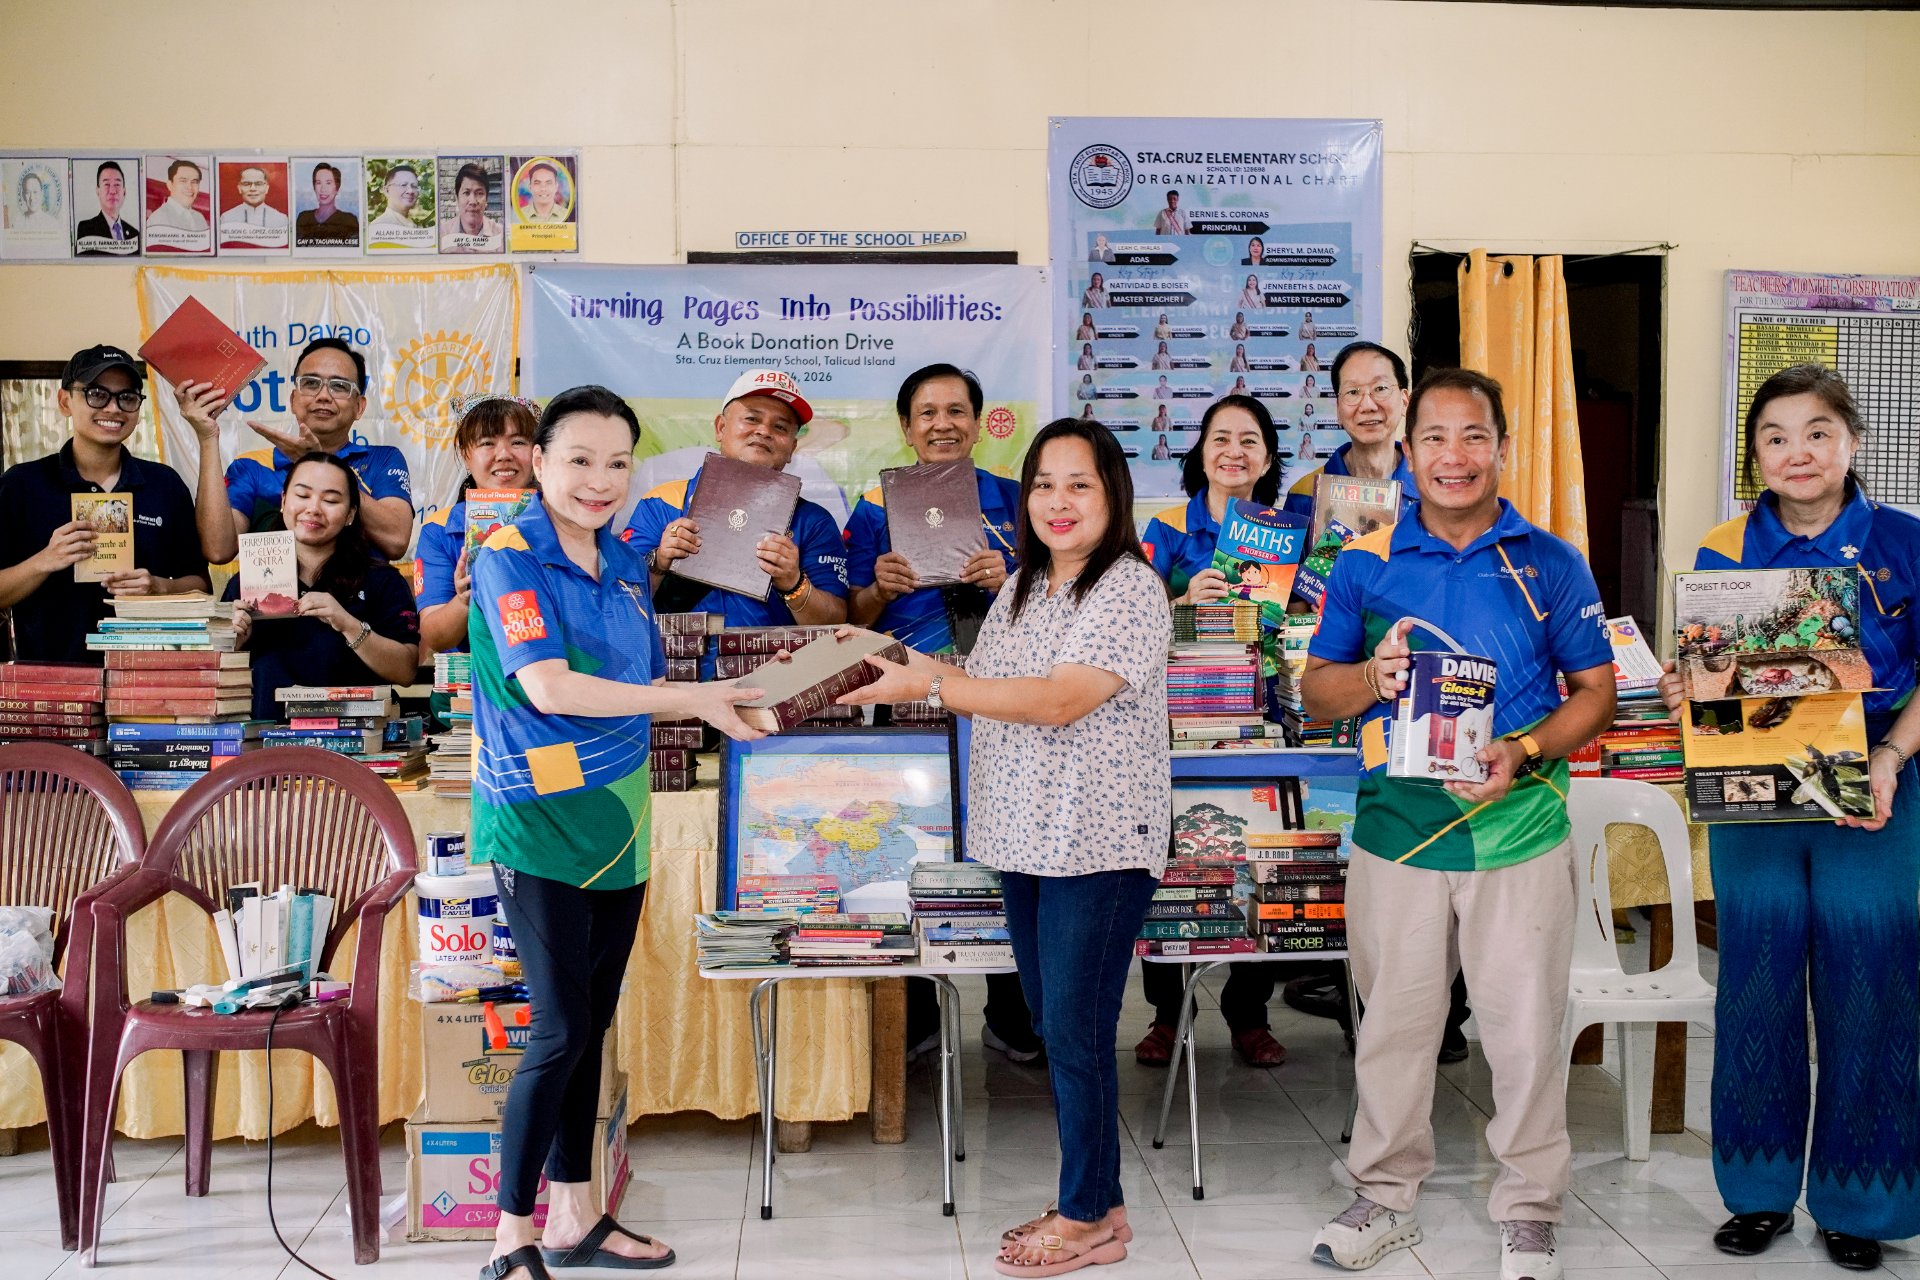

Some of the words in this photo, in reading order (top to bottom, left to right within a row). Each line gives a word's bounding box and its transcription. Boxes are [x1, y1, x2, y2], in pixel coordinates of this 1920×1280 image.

[1206, 153, 1296, 164] ELEMENTARY
[1137, 174, 1292, 186] ORGANIZATIONAL
[1190, 211, 1218, 219] BERNIE
[1220, 211, 1228, 219] S.
[1230, 212, 1269, 220] CORONAS
[1202, 224, 1242, 232] PRINCIPAL
[739, 232, 789, 246] OFFICE
[796, 232, 816, 246] OF
[820, 233, 848, 246] THE
[855, 233, 915, 246] SCHOOL
[922, 233, 962, 244] HEAD
[1791, 278, 1842, 296] MONTHLY
[1844, 280, 1916, 298] OBSERVATION
[1270, 296, 1300, 304] MASTER
[1302, 296, 1335, 304] TEACHER
[1739, 297, 1753, 305] FOR
[1755, 297, 1769, 305] THE
[569, 292, 664, 326] Turning
[684, 295, 760, 326] Pages
[780, 294, 830, 321] Into
[850, 294, 1002, 321] Possibilities:
[677, 332, 692, 349] A
[698, 332, 745, 349] Book
[752, 333, 838, 350] Donation
[846, 333, 894, 350] Drive
[676, 355, 695, 365] Sta.
[698, 355, 722, 365] Cruz
[725, 355, 781, 367] Elementary
[785, 356, 821, 367] School,
[824, 356, 860, 366] Talicud
[864, 356, 895, 366] Island
[804, 372, 832, 382] 2026
[1332, 486, 1386, 503] Math
[1244, 514, 1271, 526] ESSENTIAL
[242, 538, 263, 548] TERRY
[264, 535, 292, 546] BROOKS
[1229, 521, 1294, 554] MATHS
[118, 540, 127, 548] at
[244, 550, 256, 558] The
[258, 547, 281, 557] ELVES
[282, 548, 290, 556] of
[1244, 548, 1274, 560] NURSERY
[253, 556, 284, 567] CINTRA
[1299, 570, 1315, 585] Magic
[1686, 583, 1719, 591] FOREST
[1721, 582, 1752, 590] FLOOR
[506, 608, 536, 624] END
[503, 617, 544, 636] POLIO
[509, 626, 543, 644] NOW
[1442, 658, 1496, 685] DAVIES
[1440, 682, 1486, 697] Gloss-it
[1457, 695, 1468, 703] Dry
[175, 745, 210, 753] Chemistry
[169, 760, 177, 768] 11
[178, 760, 208, 768] Biology
[447, 842, 465, 852] DAV
[1258, 851, 1263, 859] J.
[1272, 850, 1290, 858] ROBB
[1157, 926, 1175, 935] ICE
[1203, 926, 1229, 934] FIRE
[430, 924, 487, 952] Solo
[493, 936, 516, 949] DAV
[1291, 937, 1324, 949] ROBB
[436, 954, 458, 962] LATEX
[460, 953, 482, 961] PAINT
[480, 1085, 504, 1093] Quick
